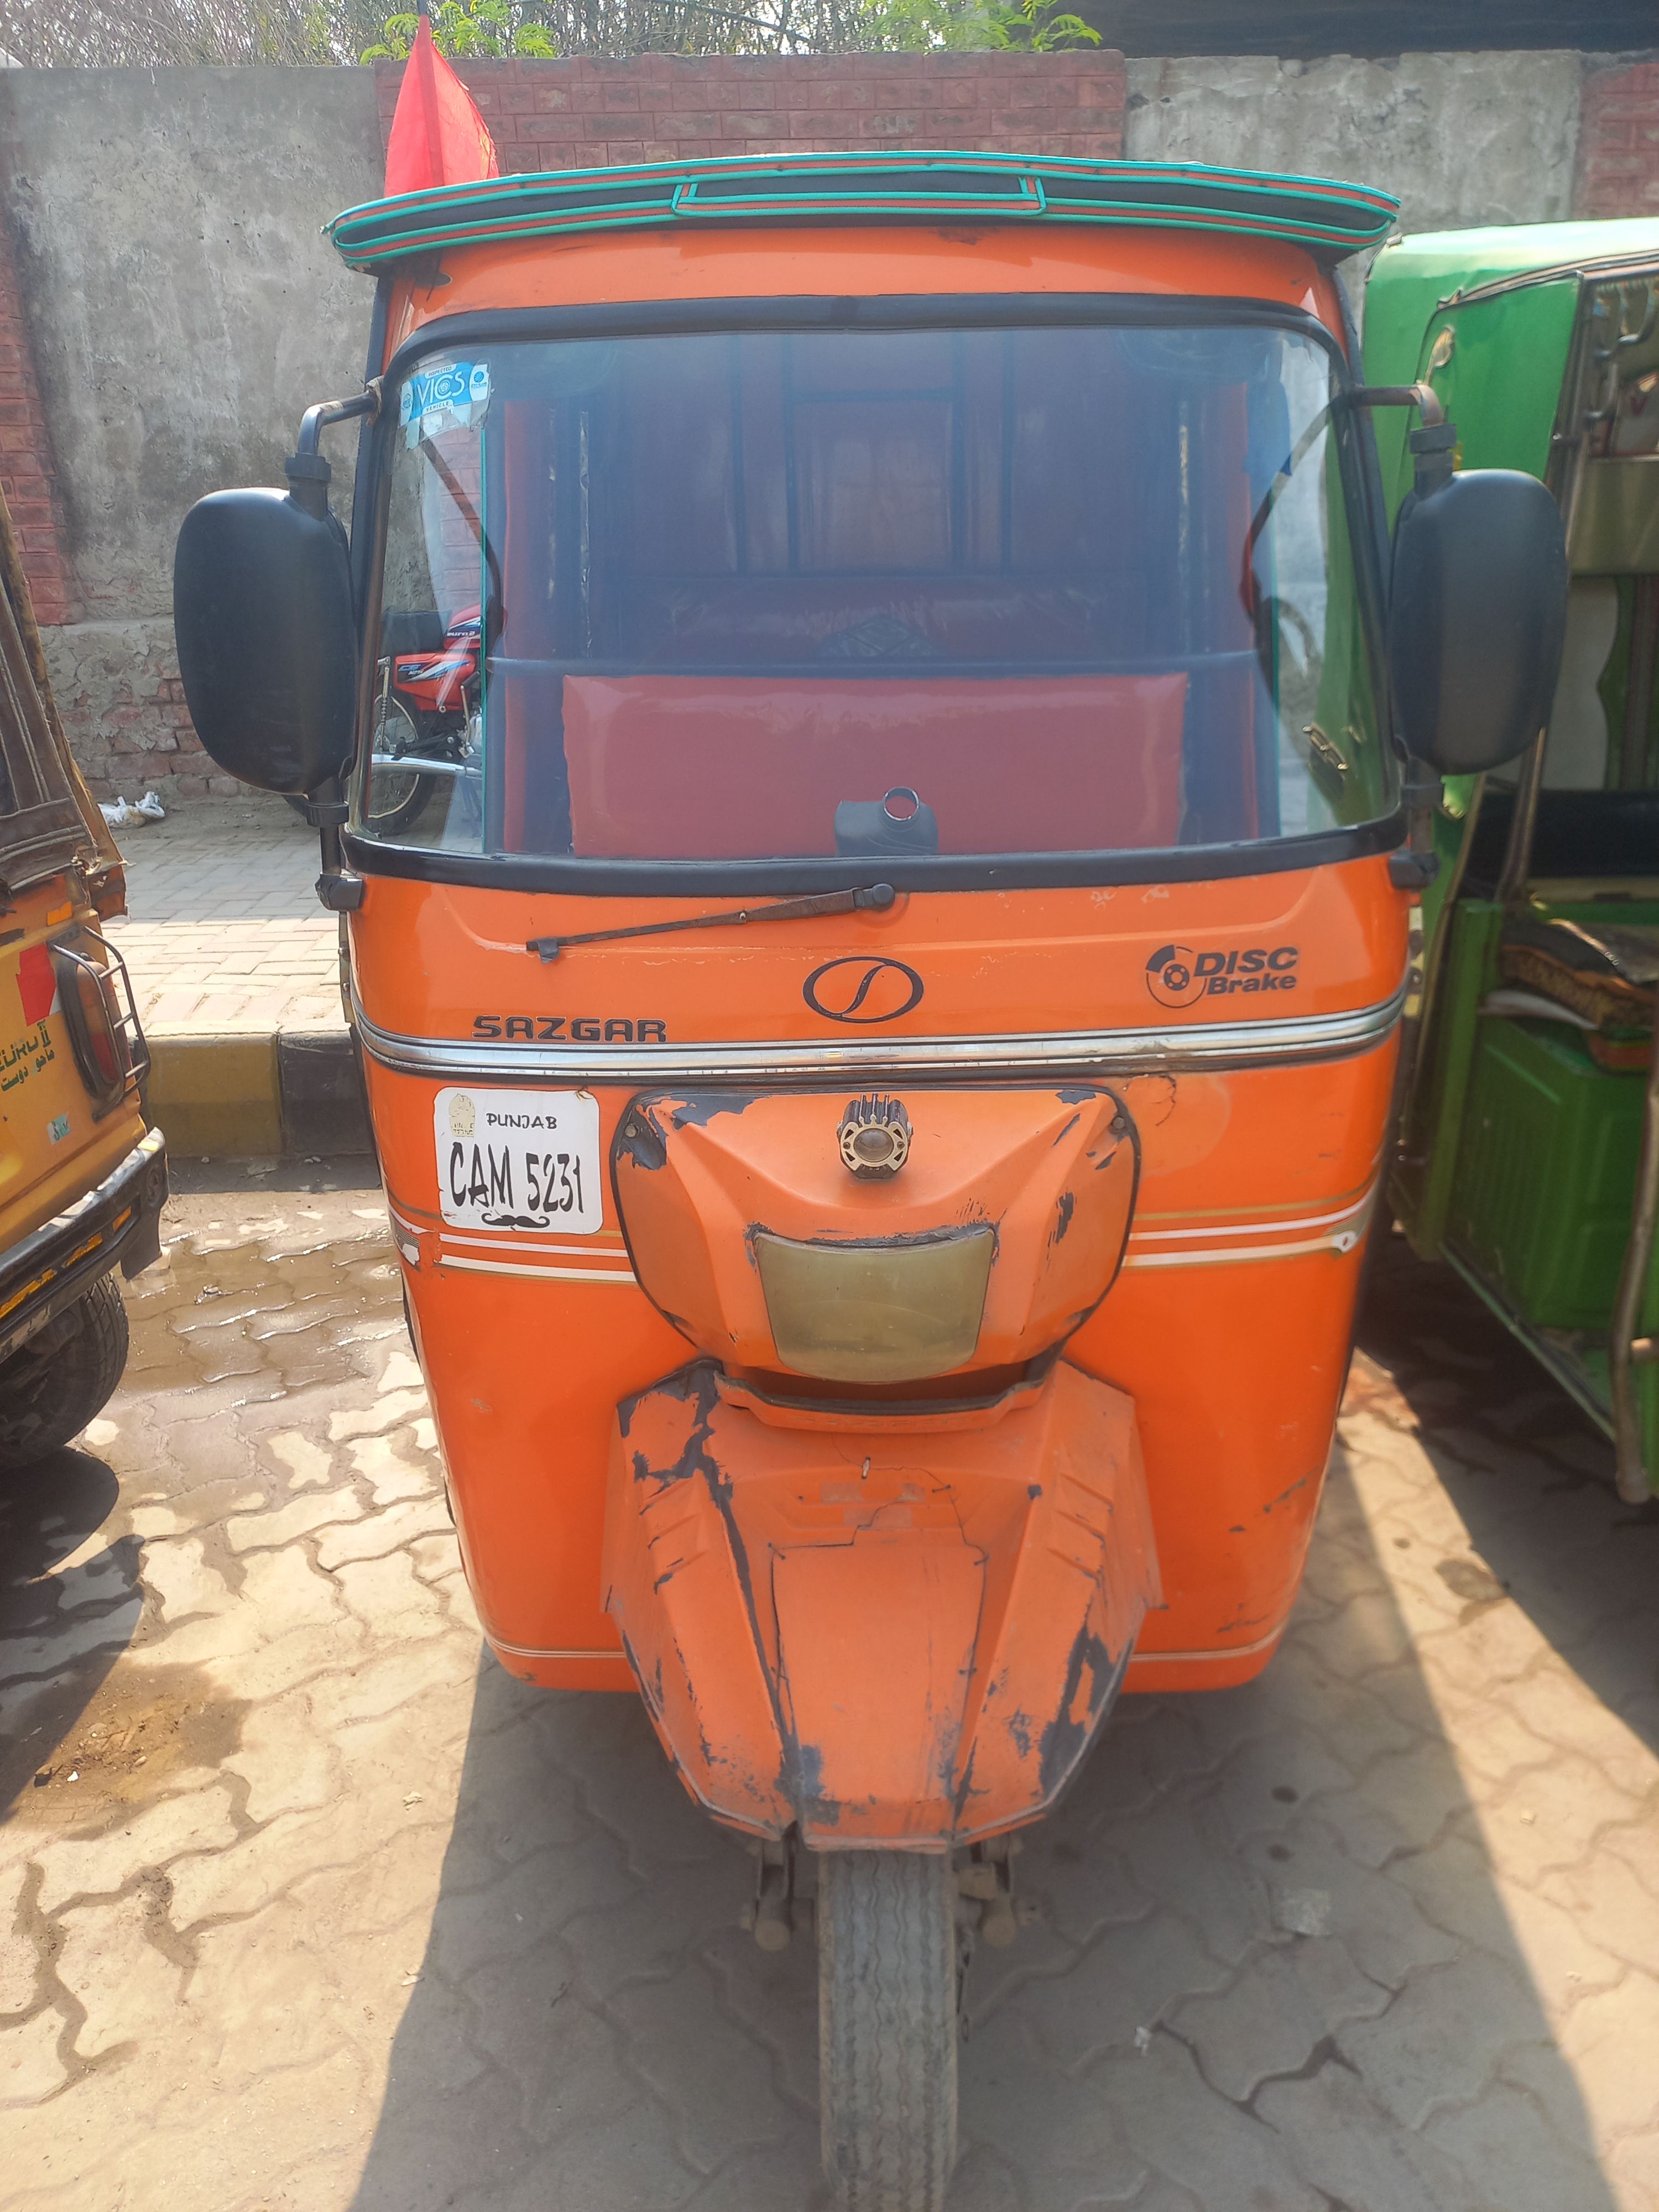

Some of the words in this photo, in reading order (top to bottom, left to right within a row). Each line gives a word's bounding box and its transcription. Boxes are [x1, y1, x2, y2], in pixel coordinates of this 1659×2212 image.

[428, 366, 452, 377] INSPECTED
[418, 371, 465, 406] VICS
[426, 401, 449, 411] VEHICLE
[1193, 947, 1298, 977] DISC
[1207, 972, 1297, 995] Brake
[472, 1015, 667, 1042] SAZGAR
[486, 1113, 557, 1129] PUNJAB
[450, 1141, 514, 1209] CAM
[526, 1152, 584, 1214] 5231
